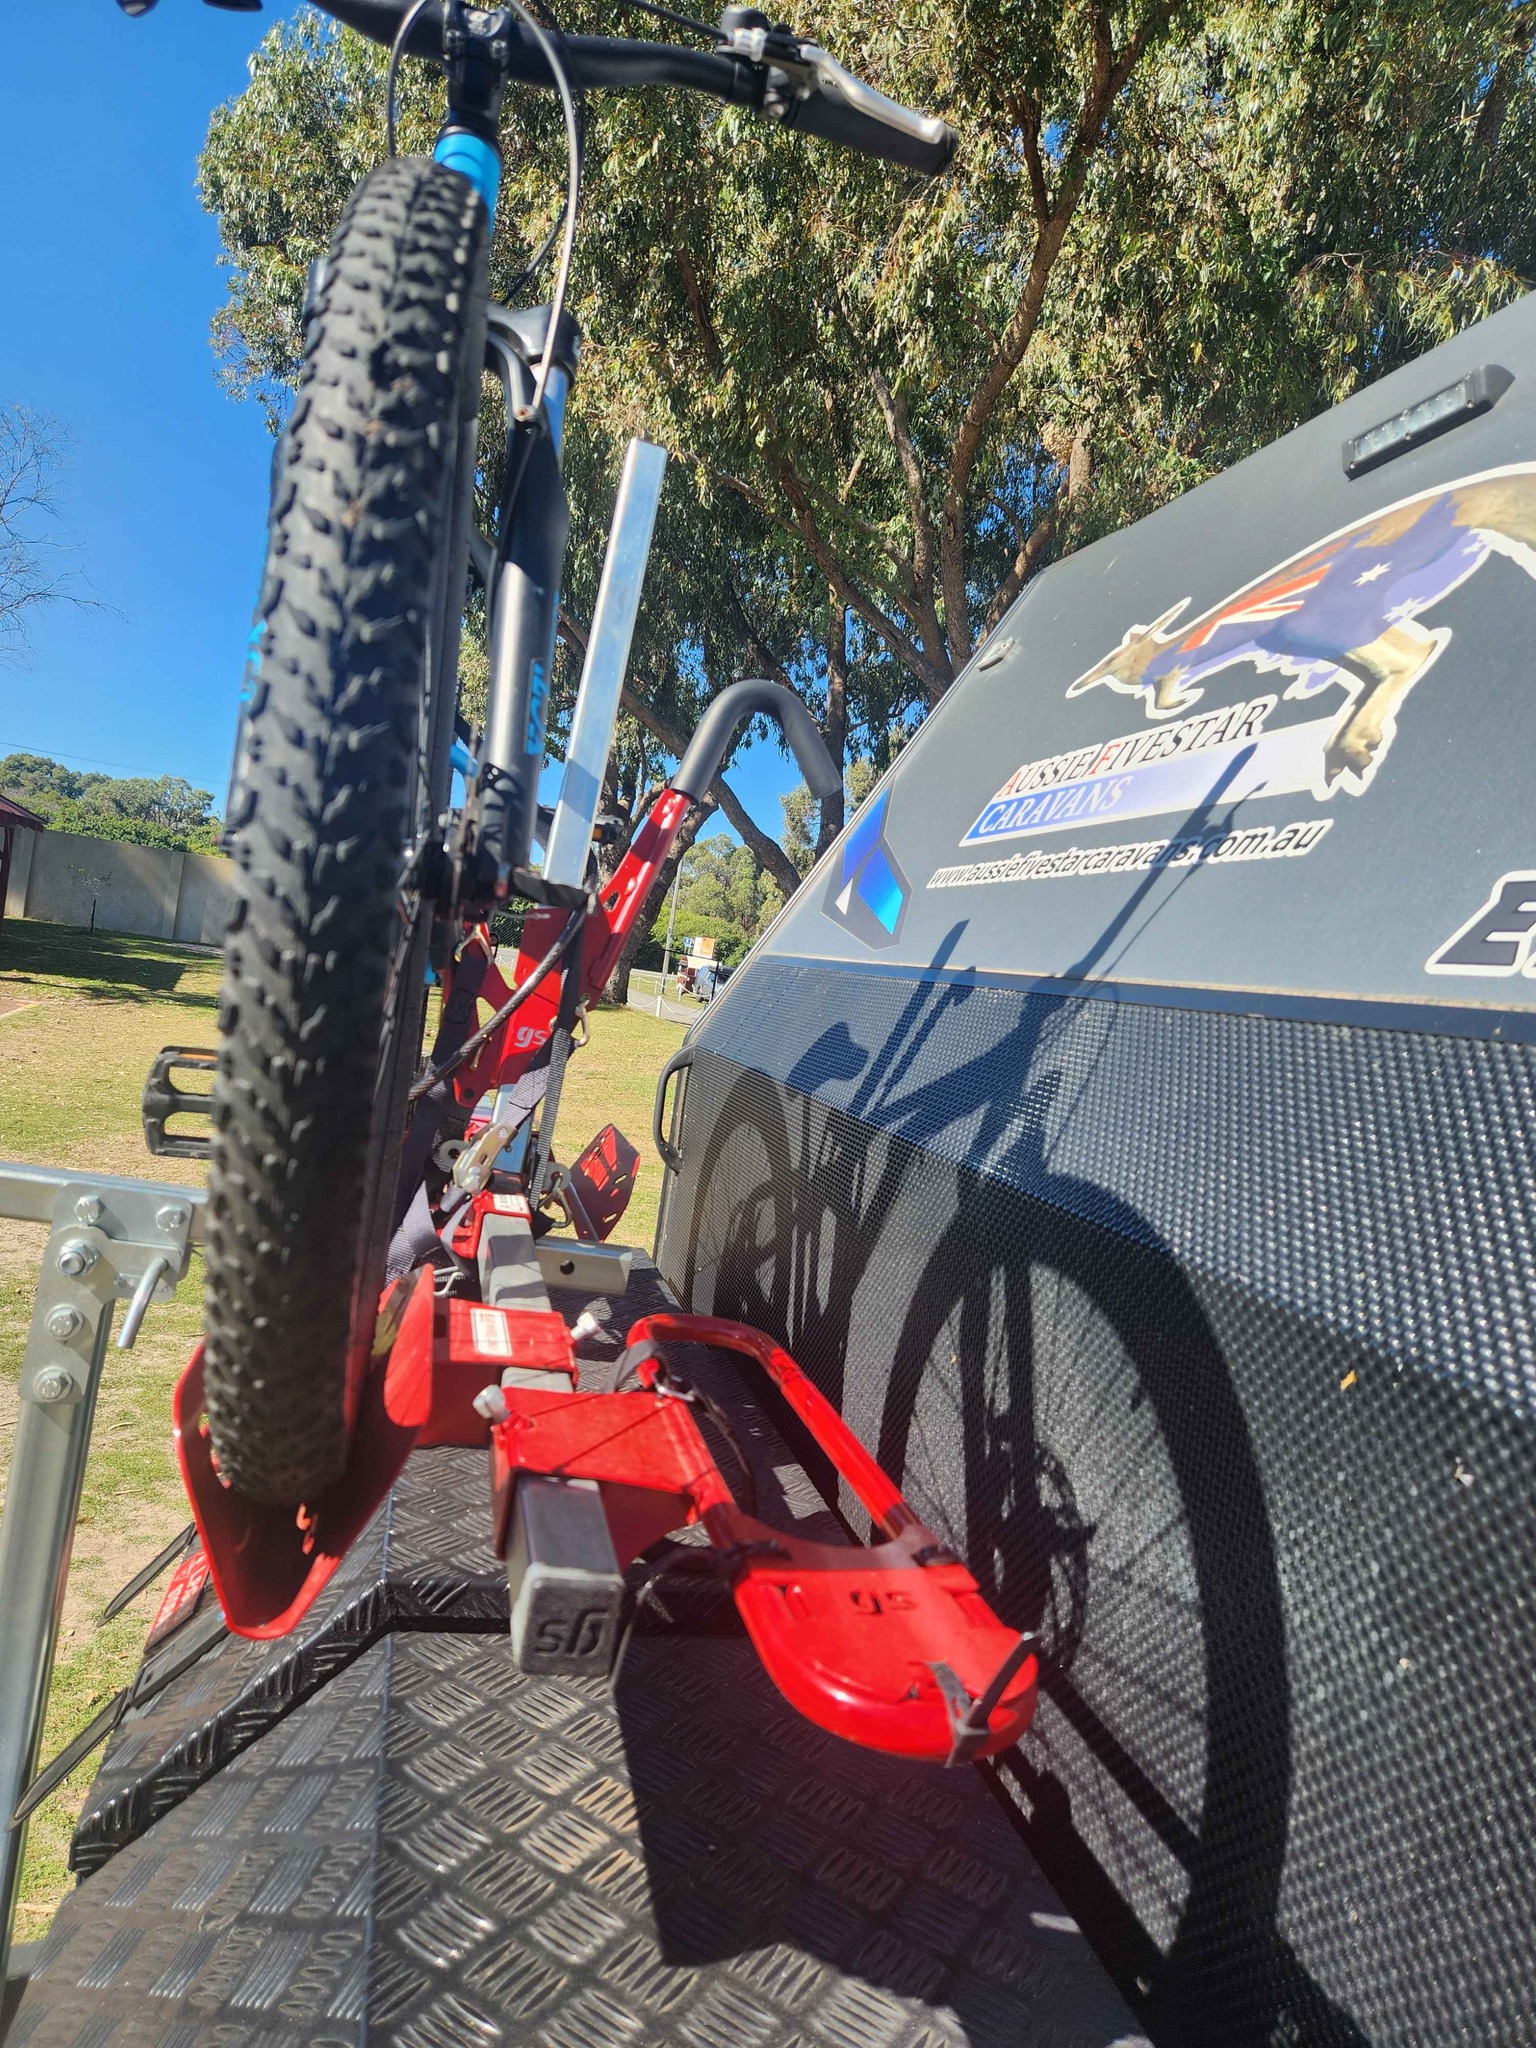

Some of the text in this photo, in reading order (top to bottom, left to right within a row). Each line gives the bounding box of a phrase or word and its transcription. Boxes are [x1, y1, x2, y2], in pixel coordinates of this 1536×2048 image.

[978, 775, 1134, 834] CARAVANS
[930, 824, 1326, 886] www.aussiefivestarcaravans.com.au
[514, 1025, 548, 1048] gs
